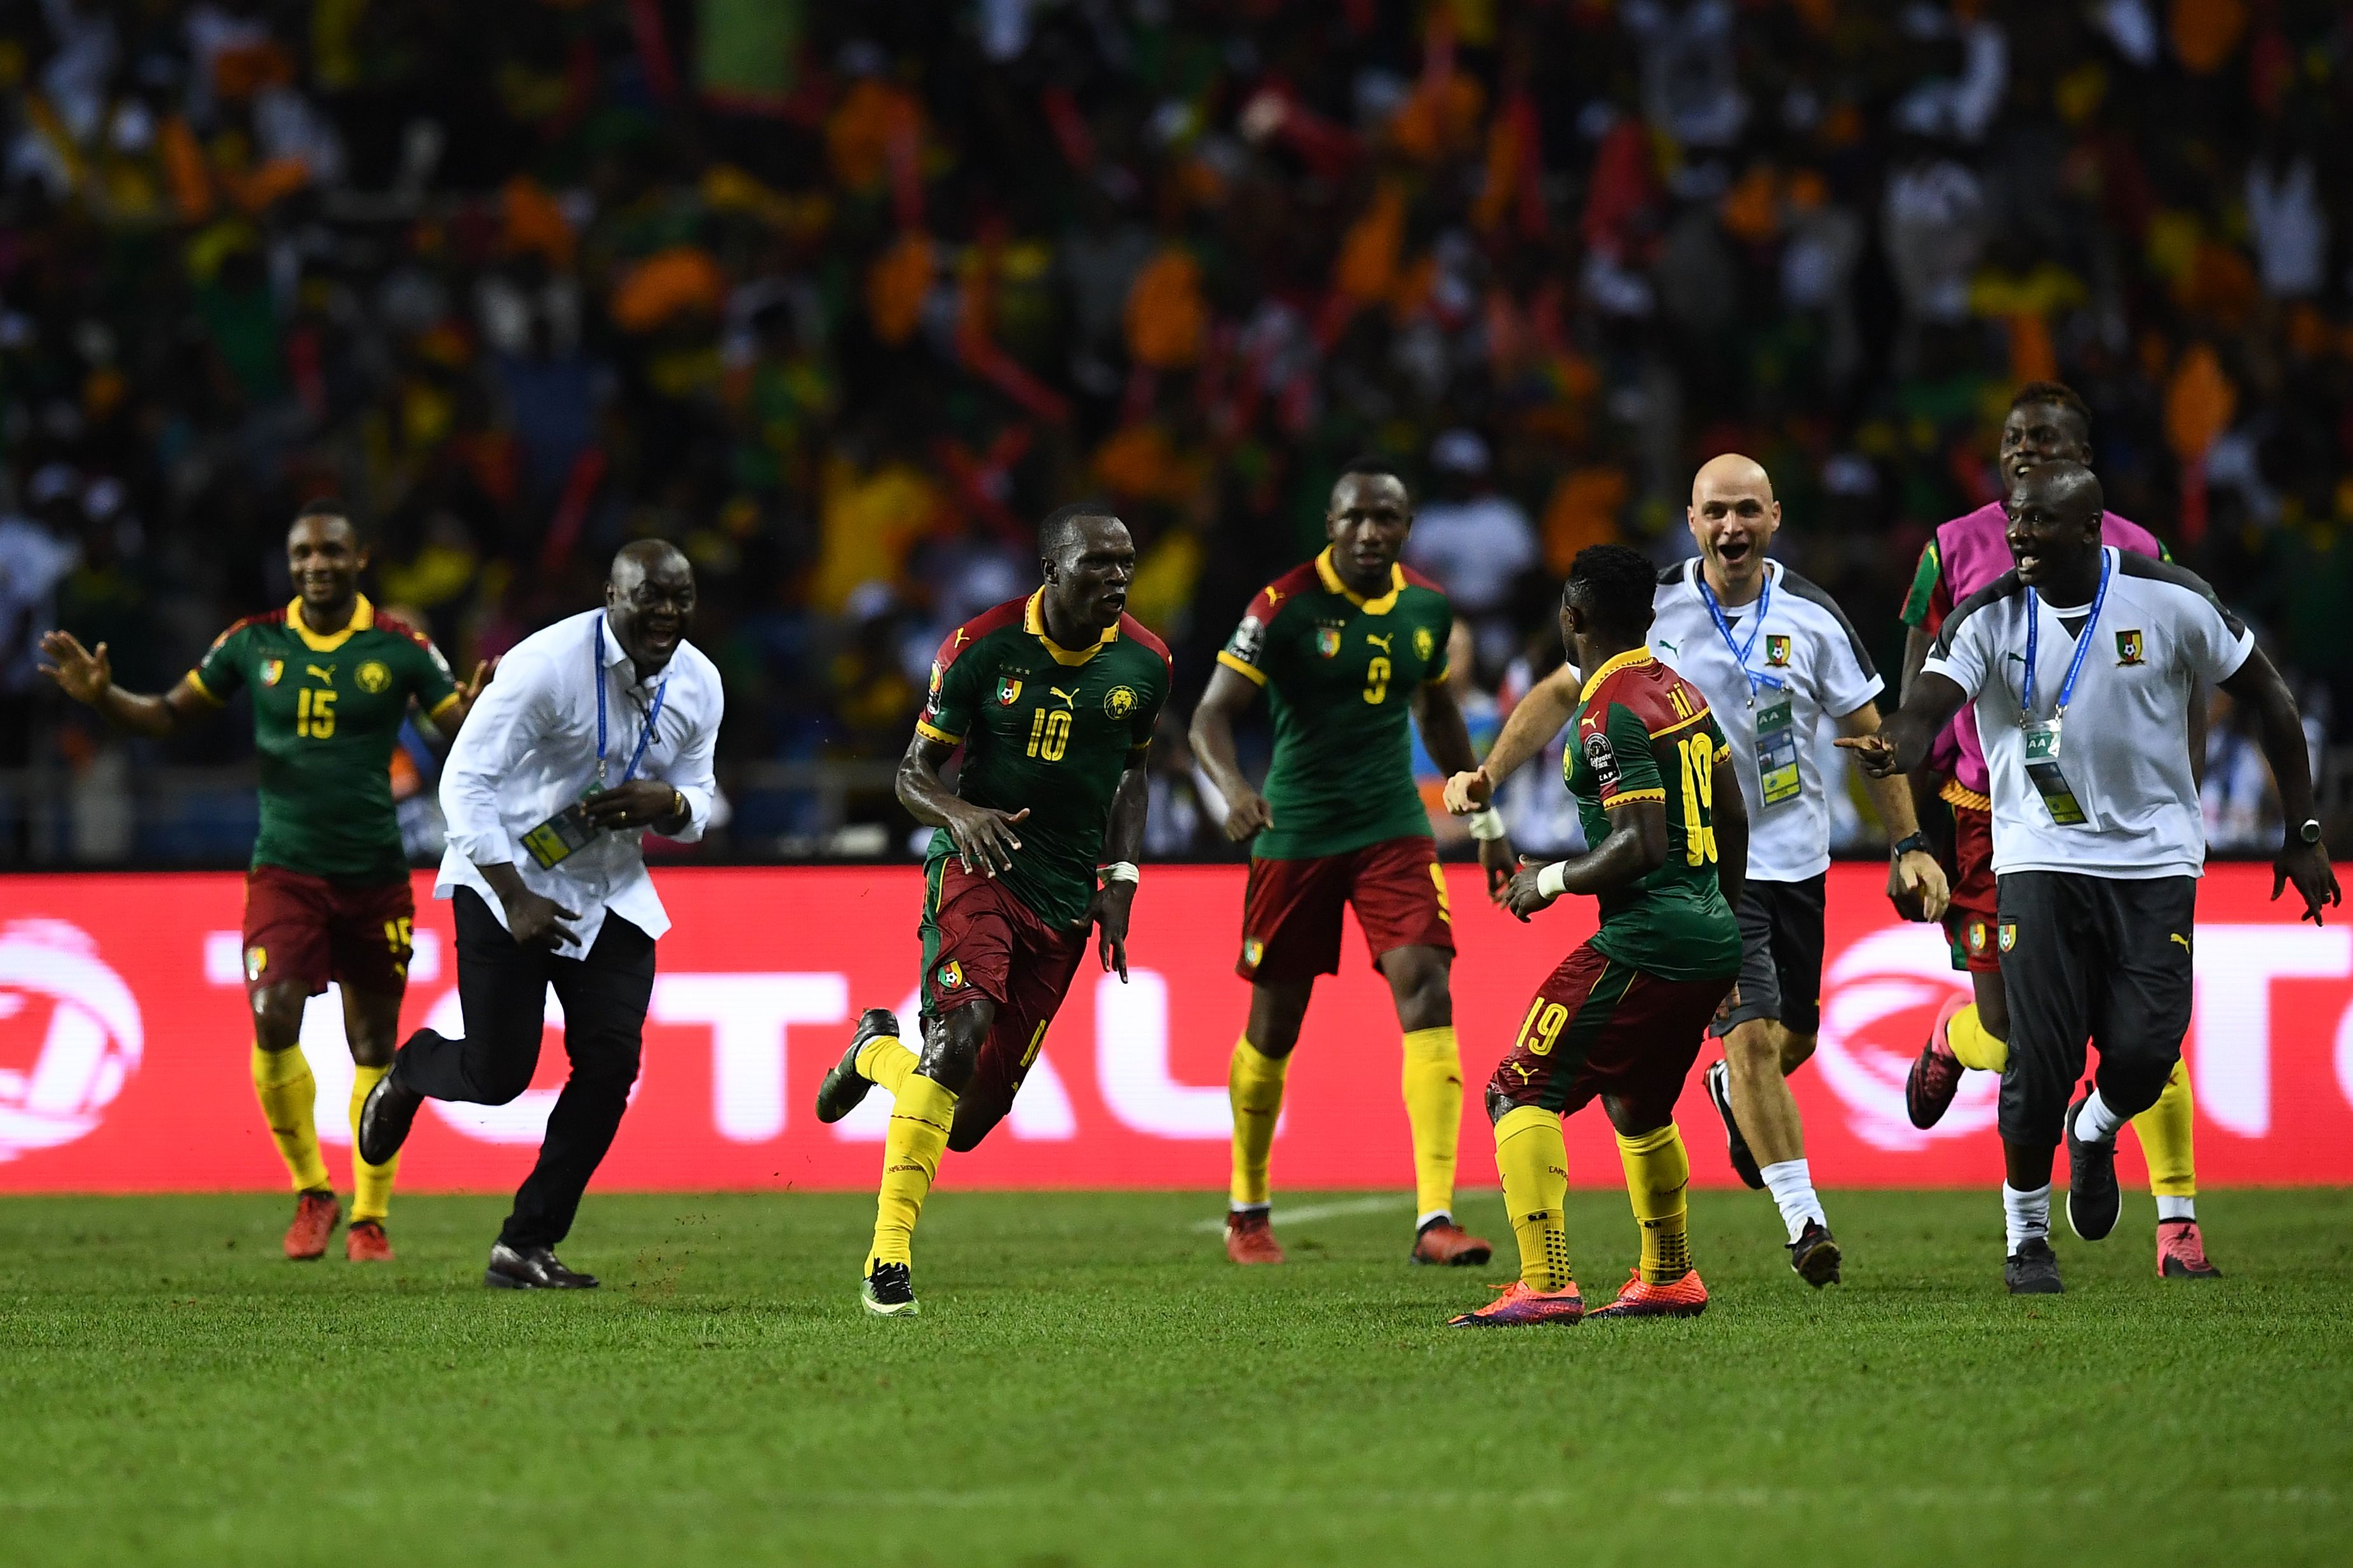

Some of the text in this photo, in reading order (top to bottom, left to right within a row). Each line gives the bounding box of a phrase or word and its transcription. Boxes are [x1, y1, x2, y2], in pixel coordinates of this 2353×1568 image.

[1363, 656, 1391, 704] 9
[297, 687, 338, 739] 15
[1027, 708, 1072, 761] 10
[2028, 738, 2046, 748] AA
[1677, 732, 1718, 866] 19
[1516, 996, 1568, 1056] 19
